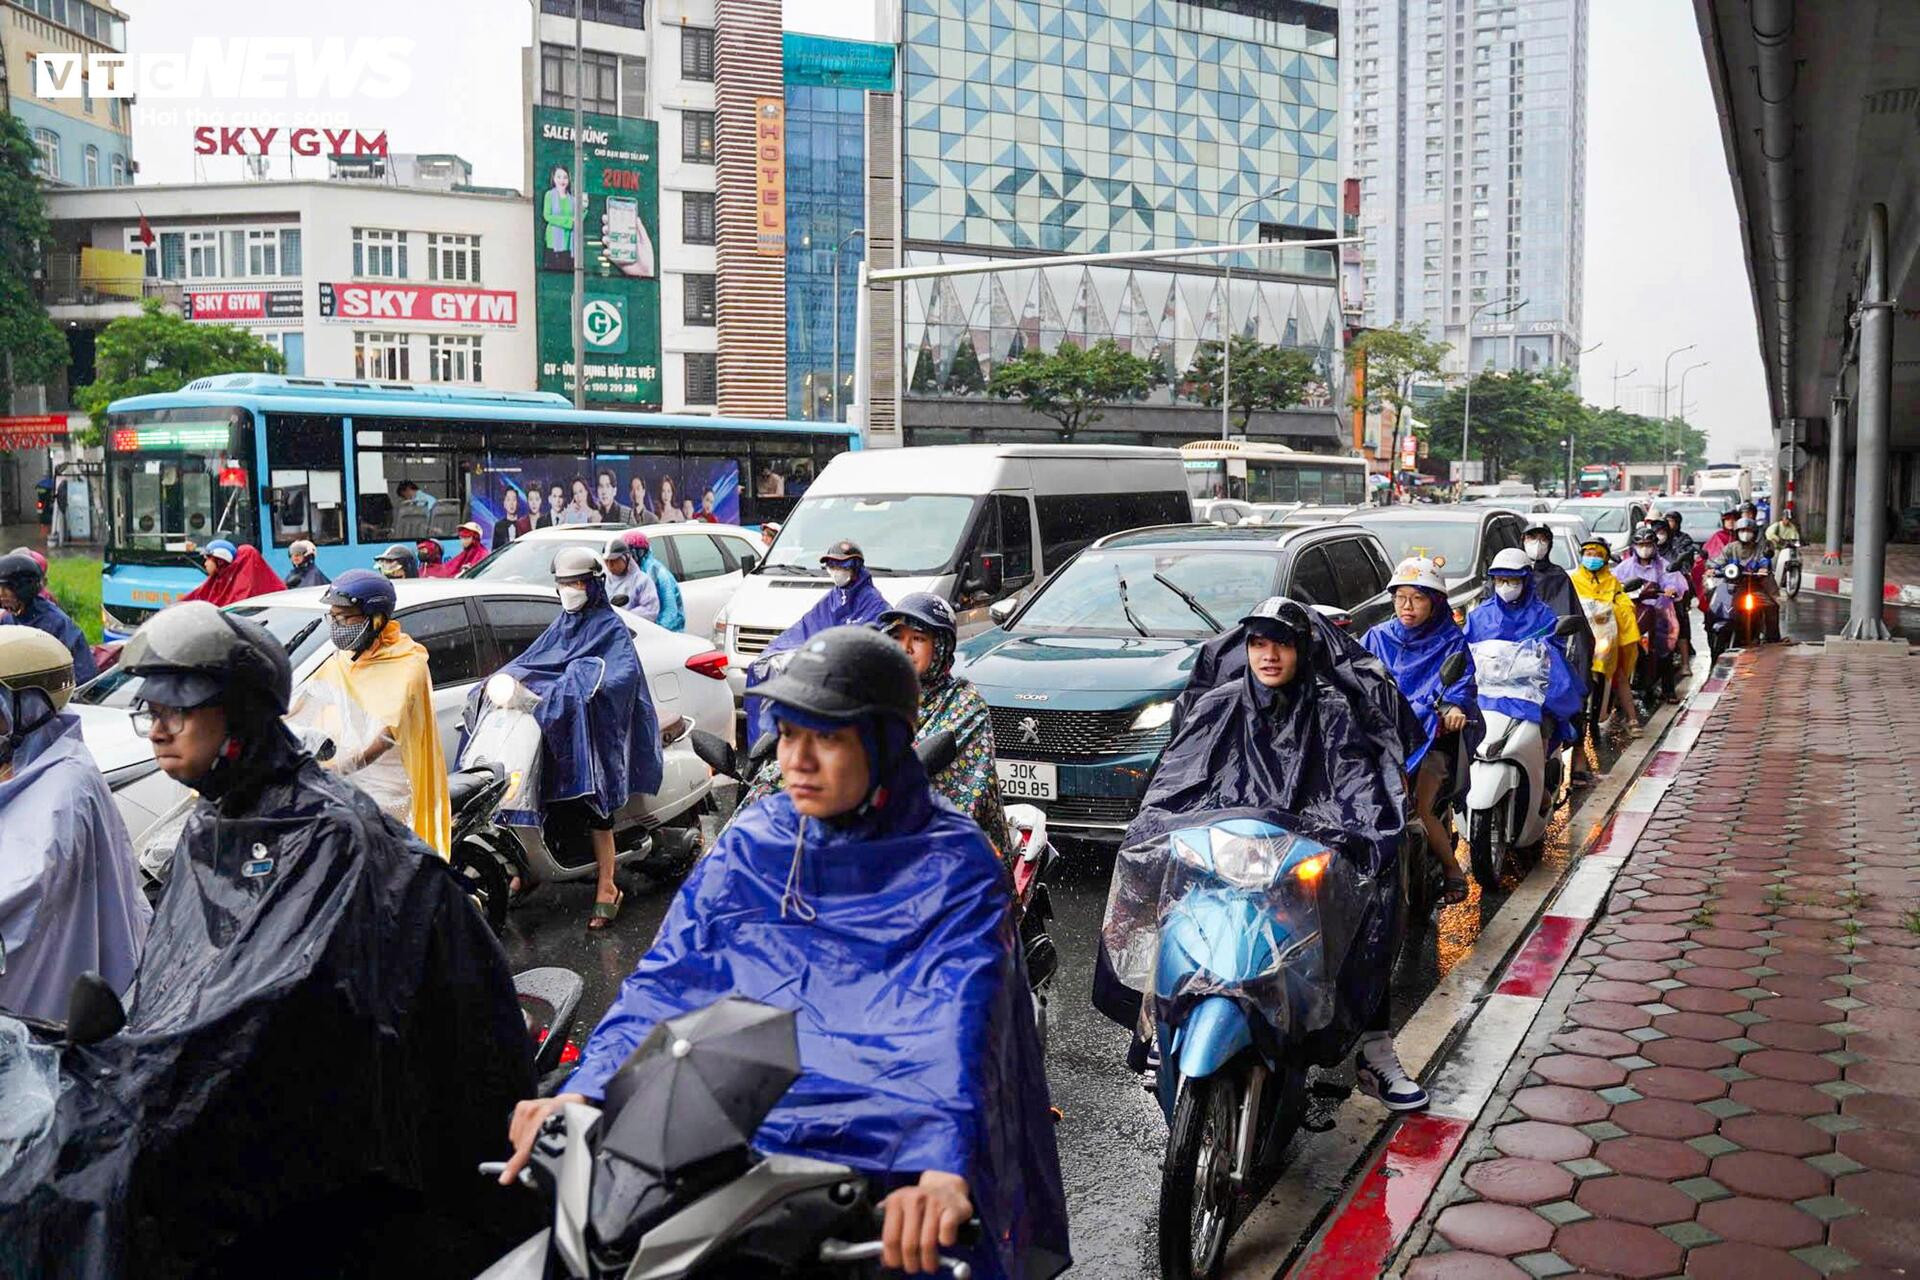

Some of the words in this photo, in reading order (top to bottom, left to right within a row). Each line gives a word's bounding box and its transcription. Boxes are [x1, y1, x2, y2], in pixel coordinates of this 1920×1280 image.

[543, 124, 570, 140] SALE
[194, 127, 280, 155] SKY
[291, 128, 388, 157] GYM
[760, 123, 780, 227] HOTEL
[195, 294, 223, 311] SKY
[227, 294, 260, 310] GYM
[342, 289, 418, 317] SKY
[432, 293, 513, 321] GYM
[625, 366, 637, 378] XE
[1009, 763, 1037, 780] 30K
[1000, 779, 1050, 797] 209.85
